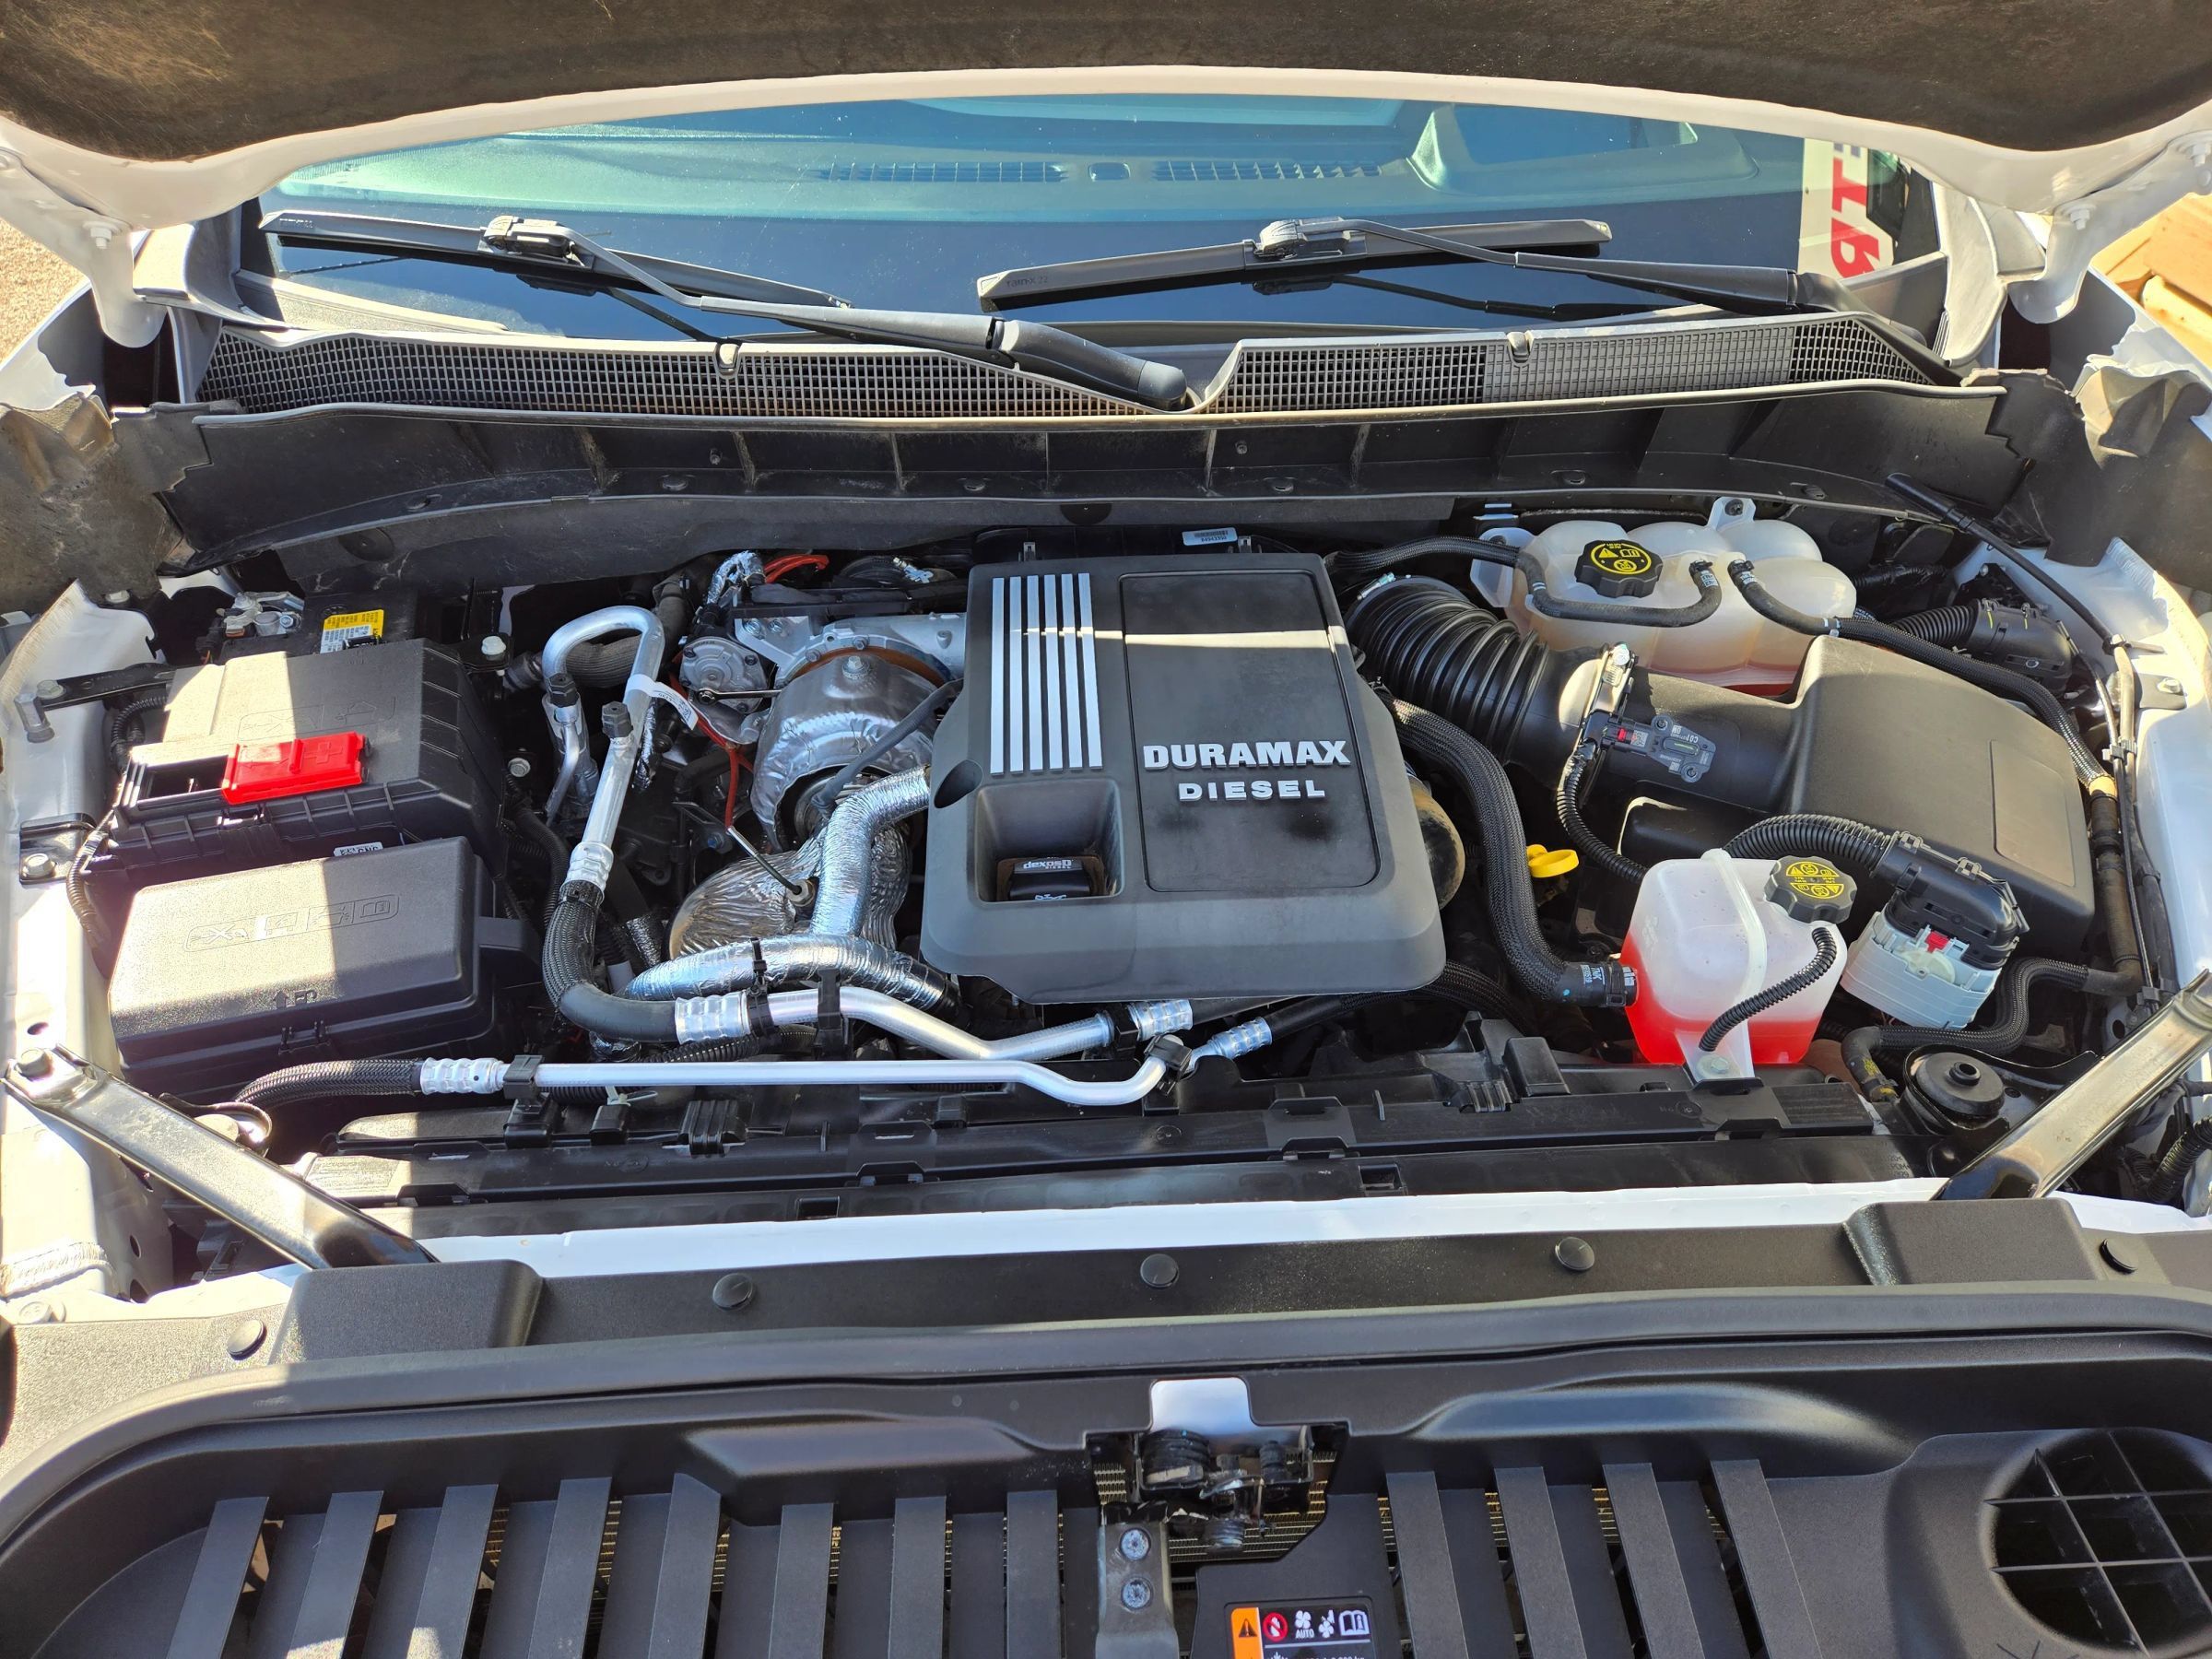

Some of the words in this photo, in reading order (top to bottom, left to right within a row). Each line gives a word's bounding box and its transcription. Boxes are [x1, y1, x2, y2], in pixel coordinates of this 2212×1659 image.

[1143, 740, 1351, 770] DURAMAX
[1178, 780, 1325, 801] DIESEL
[1295, 1629, 1315, 1639] AUTO
